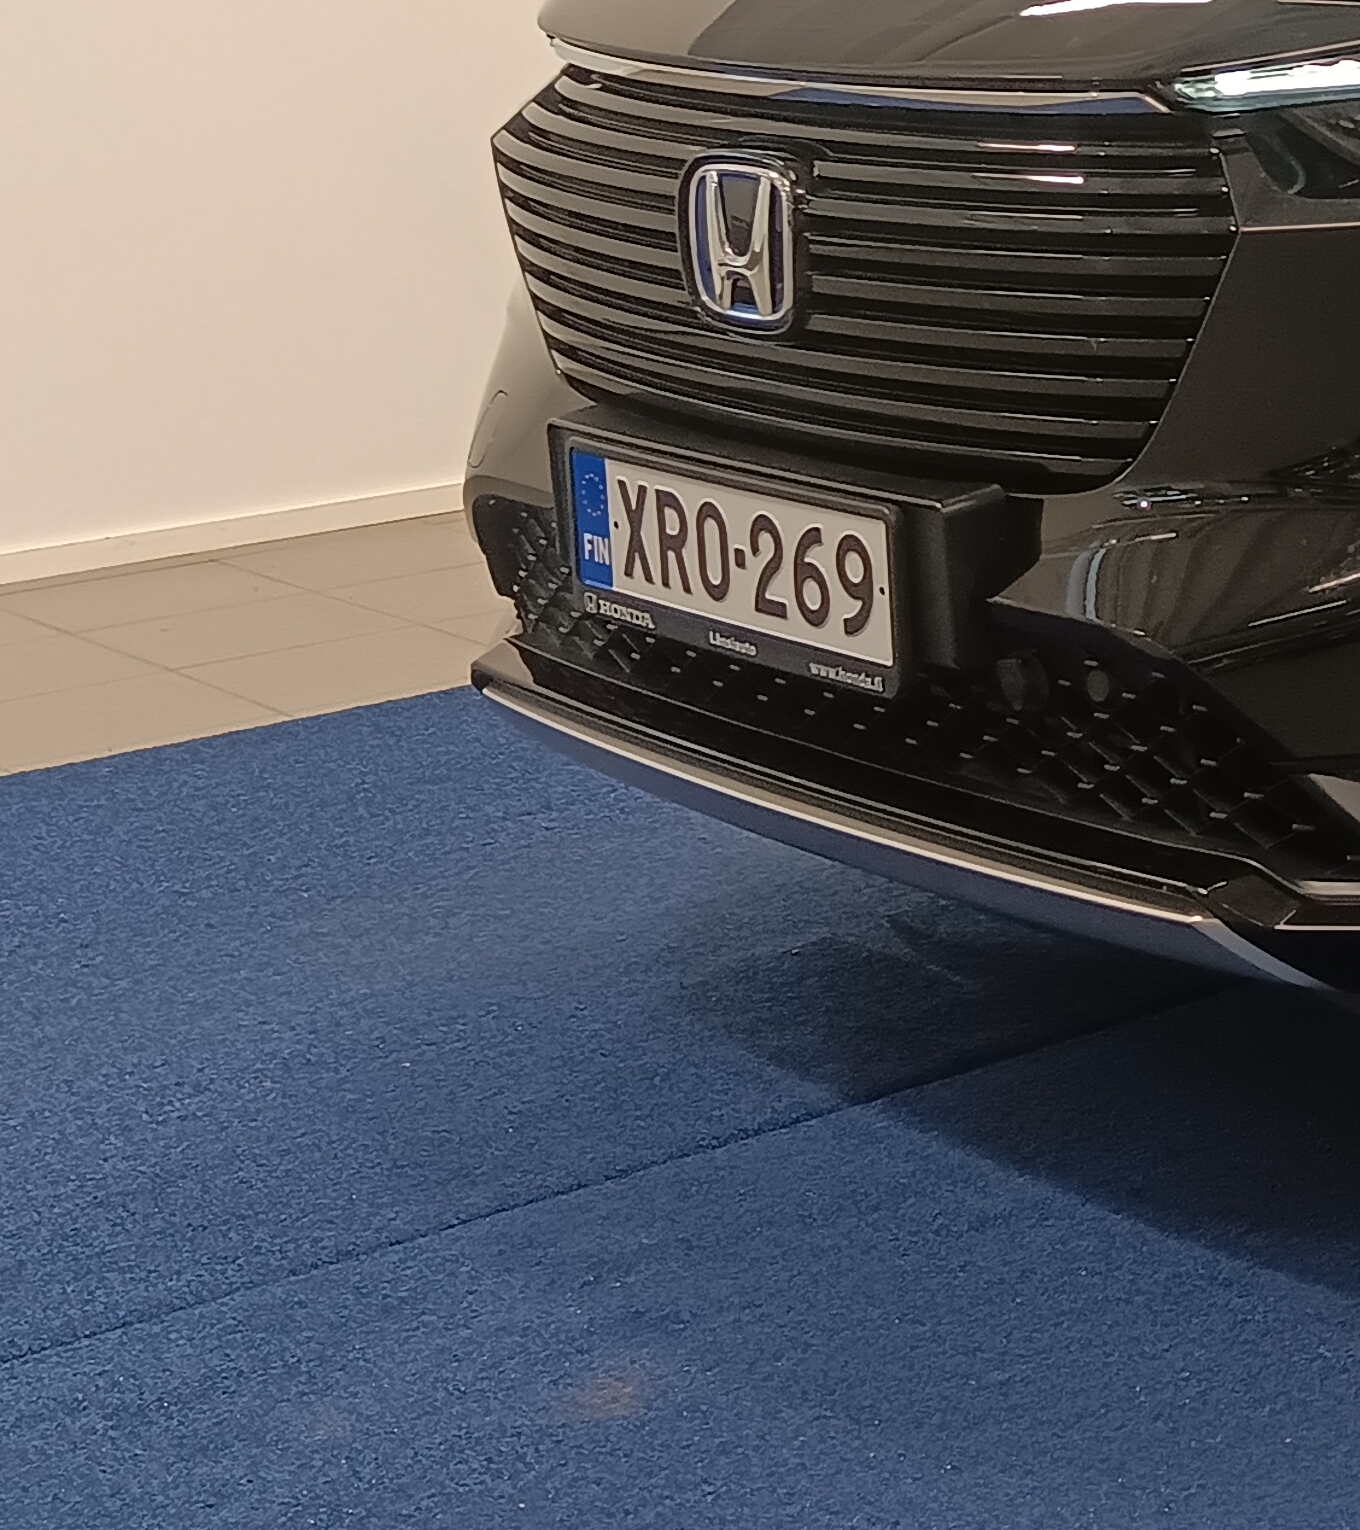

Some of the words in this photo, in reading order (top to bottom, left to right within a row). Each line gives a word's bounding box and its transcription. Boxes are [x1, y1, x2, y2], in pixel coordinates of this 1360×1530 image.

[583, 532, 610, 566] FIN
[616, 477, 874, 637] XRO-269
[598, 599, 656, 629] HONDA
